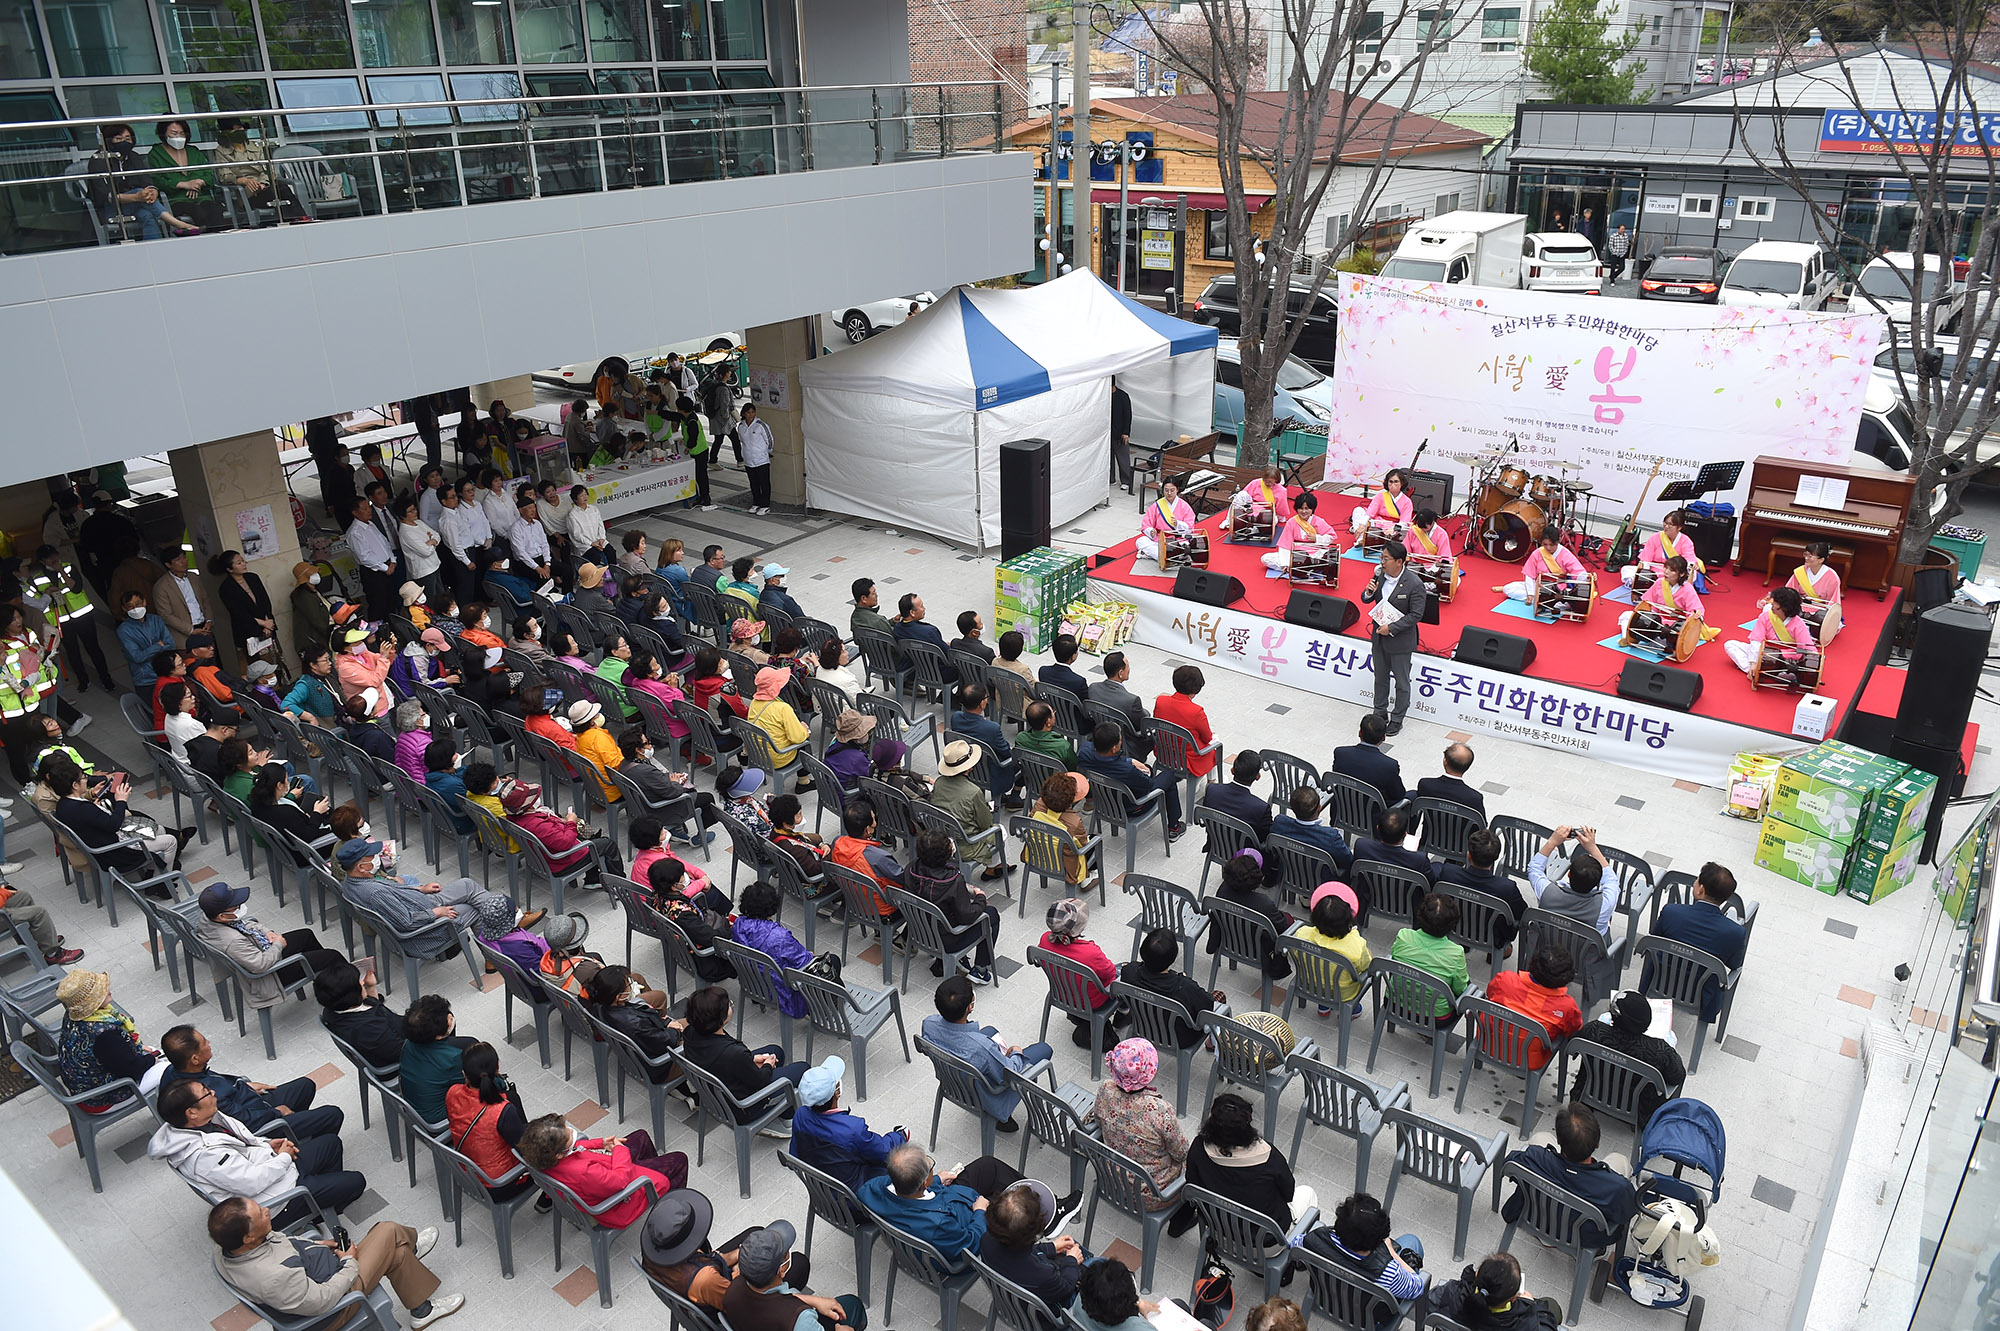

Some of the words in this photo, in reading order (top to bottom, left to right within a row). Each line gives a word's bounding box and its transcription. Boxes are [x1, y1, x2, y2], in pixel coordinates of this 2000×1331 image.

[1491, 313, 1558, 338] 칠산서부동
[1563, 313, 1659, 352] 주민화합한마당
[1477, 353, 1527, 392] 사월
[1544, 365, 1569, 391] 愛
[1588, 345, 1643, 426] 봄
[1535, 431, 1557, 443] 화요일
[1519, 444, 1538, 455] 오후
[1541, 446, 1556, 457] 3시
[1171, 611, 1222, 657] 사월
[1226, 626, 1251, 656] 愛
[1257, 625, 1289, 677] 봄
[1493, 719, 1591, 751] 칠산서부동주민자치회
[1777, 789, 1789, 799] FAN
[1762, 838, 1774, 848] FAN
